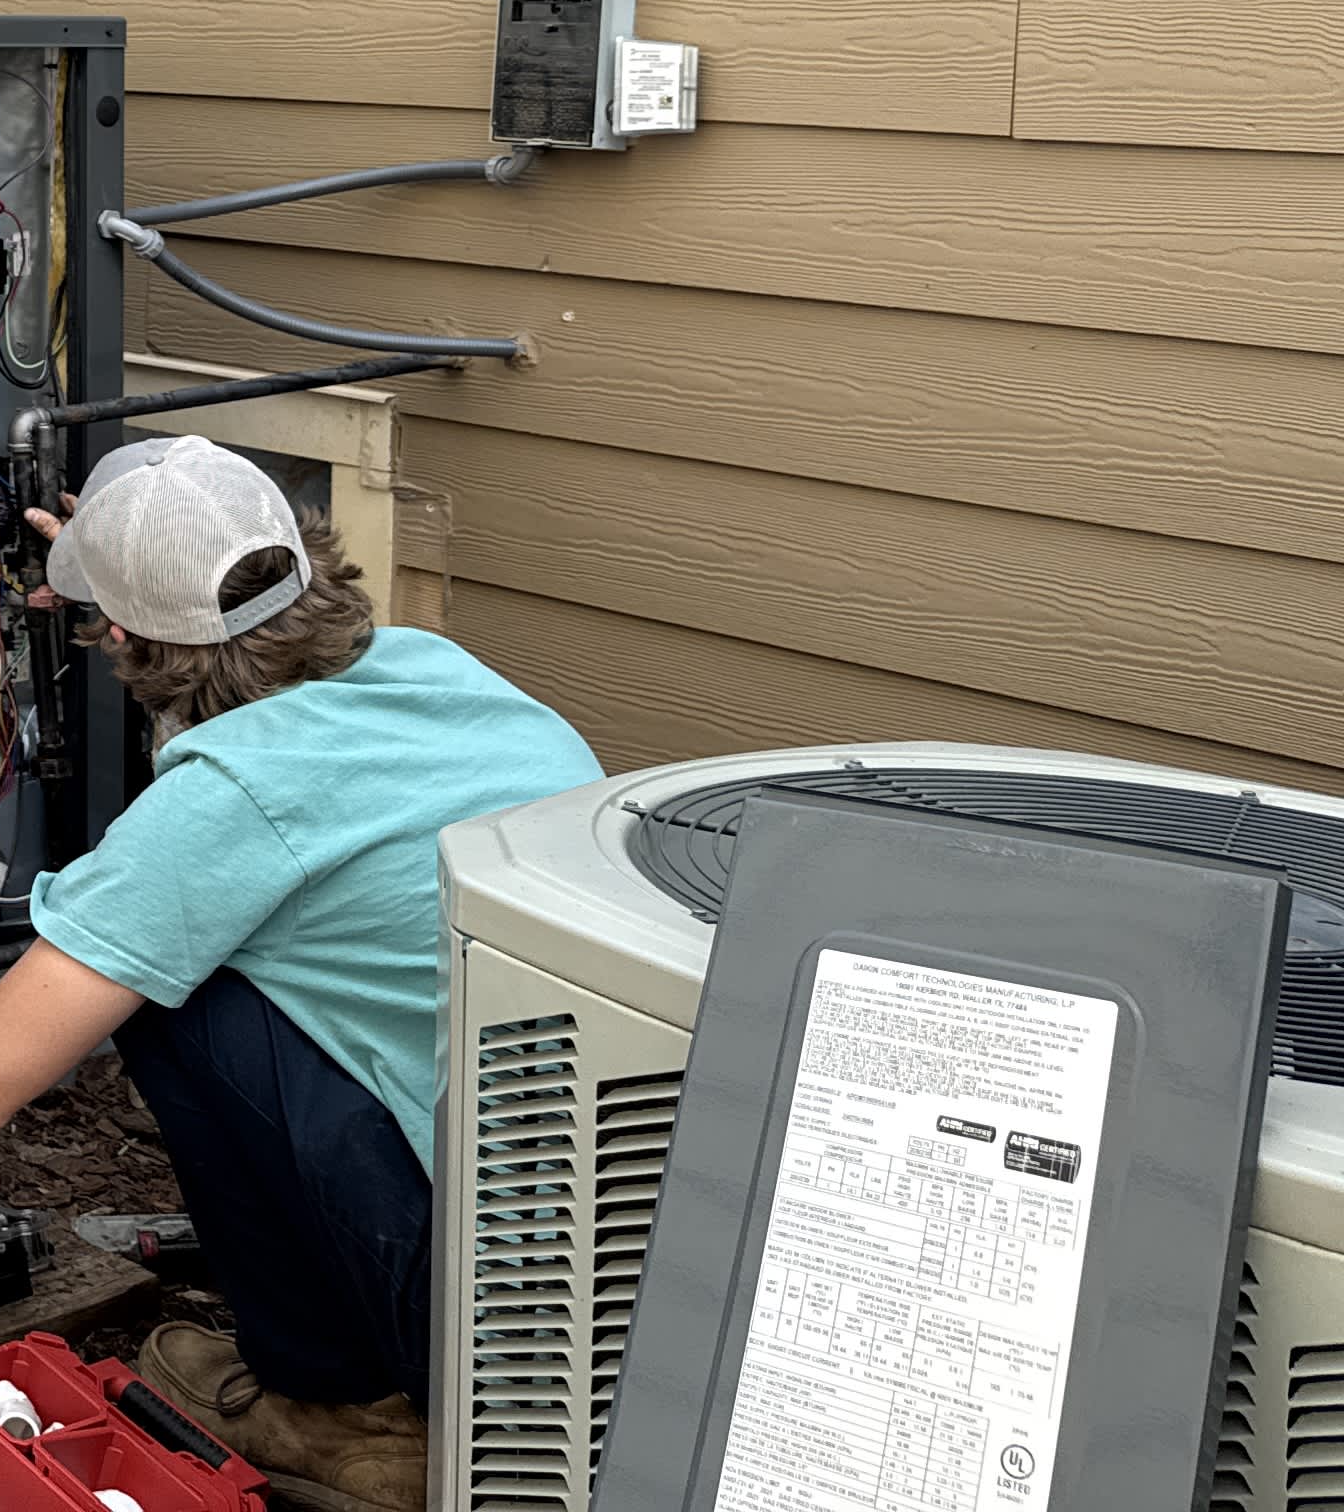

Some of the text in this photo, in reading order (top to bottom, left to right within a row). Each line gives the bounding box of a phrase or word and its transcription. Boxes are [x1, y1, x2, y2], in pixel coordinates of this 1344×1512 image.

[880, 966, 918, 981] COMFORT
[921, 974, 983, 992] TECHNOLOGIES
[1007, 1449, 1027, 1474] UL
[996, 1475, 1031, 1496] LISTED
